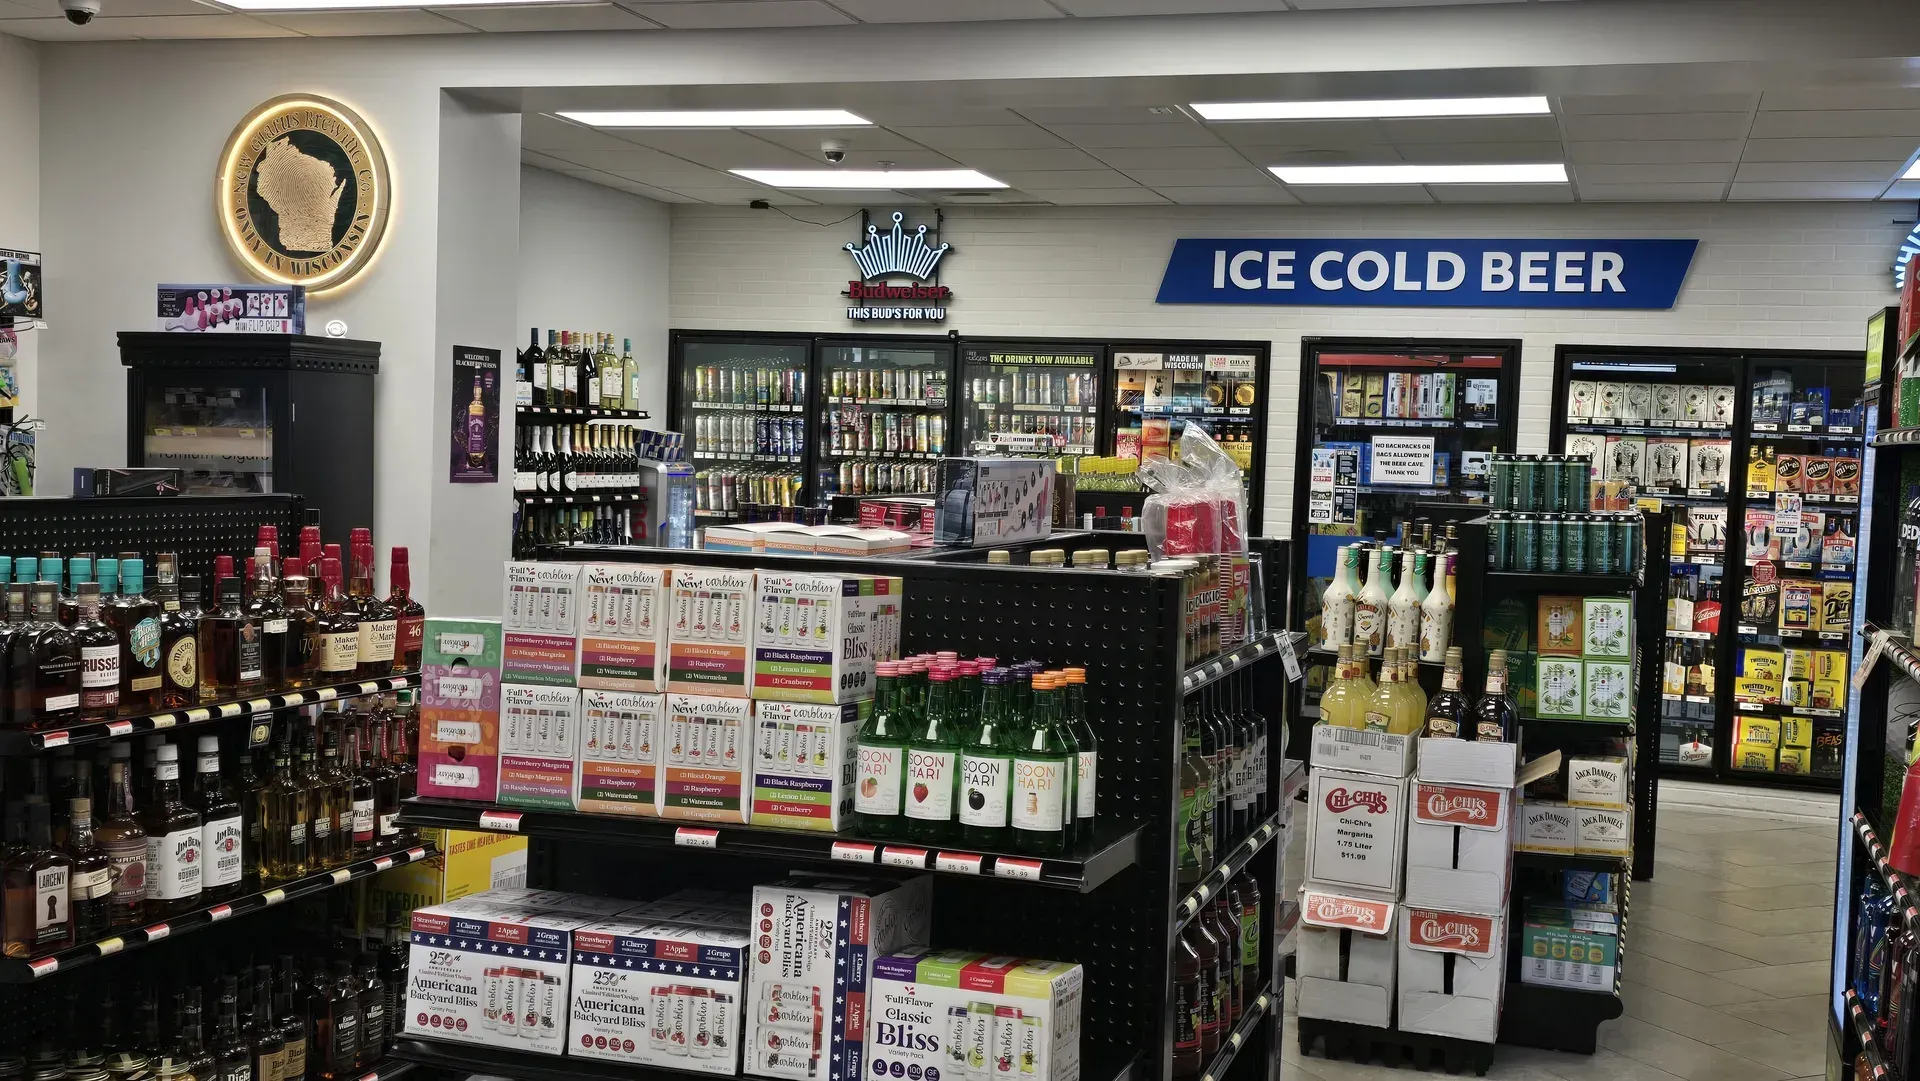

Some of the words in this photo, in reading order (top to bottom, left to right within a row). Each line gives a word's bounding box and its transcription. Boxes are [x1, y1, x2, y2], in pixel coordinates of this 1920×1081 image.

[233, 152, 254, 194] New
[251, 110, 300, 152] Glarus
[304, 110, 365, 164] Brewing
[234, 206, 265, 252] ONLY
[264, 252, 285, 272] IN
[290, 211, 370, 277] WISCONSIN
[1212, 250, 1296, 290] ICE
[1308, 250, 1467, 292] COLD
[1480, 251, 1627, 293] BEER
[848, 281, 949, 299] Budweiser
[848, 308, 870, 319] THIS
[872, 308, 902, 319] BUD'S
[903, 308, 922, 319] FOR
[925, 308, 944, 319] YOU
[249, 321, 264, 332] FLIP
[266, 320, 280, 332] CUP
[990, 354, 1004, 363] THC
[1005, 354, 1033, 364] DRINKS
[1034, 355, 1053, 364] NOW
[1054, 355, 1094, 365] AVAILABLE
[1694, 513, 1719, 521] TRULY
[509, 566, 526, 575] Full
[538, 569, 574, 582] carbliss
[509, 575, 536, 583] Flavor
[588, 574, 614, 585] New!
[616, 570, 657, 584] carbliss
[676, 578, 703, 589] New!
[705, 577, 747, 589] carbliss
[795, 581, 836, 593] carbliss
[763, 586, 793, 595] Flavor
[409, 625, 421, 638] 46
[847, 622, 866, 633] Classic
[342, 644, 358, 652] Mark
[514, 637, 544, 645] Strawberry
[545, 638, 573, 647] Margarita
[620, 644, 641, 652] Orange
[538, 651, 566, 659] Margarita
[843, 638, 868, 660] Bliss
[606, 656, 636, 665] Raspberry
[772, 652, 789, 660] Black
[789, 654, 823, 662] Raspberry
[604, 668, 638, 677] Watermelon
[778, 665, 796, 673] Lemon
[797, 666, 816, 674] Lime
[780, 678, 814, 687] Cranberry
[1765, 685, 1774, 693] TEA
[857, 752, 892, 764] SOON
[909, 754, 945, 768] SOON
[858, 764, 887, 776] HARI
[963, 759, 1000, 775] SOON
[1016, 763, 1056, 778] SOON
[909, 768, 939, 780] HARI
[1575, 769, 1592, 781] JACK
[1591, 767, 1618, 782] DANIEL'S
[964, 774, 995, 787] HARI
[1018, 777, 1051, 790] HARI
[490, 821, 513, 830] $22.49
[1339, 818, 1372, 828] Chi-Chi's
[1528, 814, 1544, 826] JACK
[1544, 811, 1571, 828] DANIEL'S
[1581, 817, 1598, 828] JACK
[1598, 813, 1625, 831] DANIEL'S
[214, 830, 226, 845] JIM
[227, 826, 241, 839] BEAM
[1337, 829, 1373, 839] Margarita
[449, 843, 466, 855] TASTES
[1337, 840, 1354, 848] 1.75
[1355, 841, 1373, 850] Liter
[893, 858, 914, 866] $5.99
[1341, 852, 1366, 861] $11.99
[217, 857, 240, 870] BOURBON
[38, 871, 66, 890] LARCENY
[416, 916, 448, 927] Strawberry
[460, 921, 481, 931] Cherry
[781, 894, 795, 954] Backyard
[502, 927, 519, 936] Apple
[540, 931, 559, 941] Grape
[793, 895, 808, 979] Americana
[782, 955, 793, 978] Bliss
[411, 975, 477, 995] Americana
[410, 989, 454, 1005] Backyard
[455, 994, 478, 1008] Bliss
[885, 994, 904, 1004] Full
[904, 996, 933, 1008] Flavor
[429, 1005, 445, 1013] Variety
[574, 995, 645, 1016] Americana
[573, 1010, 620, 1026] Backyard
[621, 1016, 646, 1028] Bliss
[885, 1007, 932, 1025] Classic
[875, 1021, 939, 1052] Bliss
[888, 1049, 909, 1058] Variety
[909, 1052, 925, 1060] Pack
